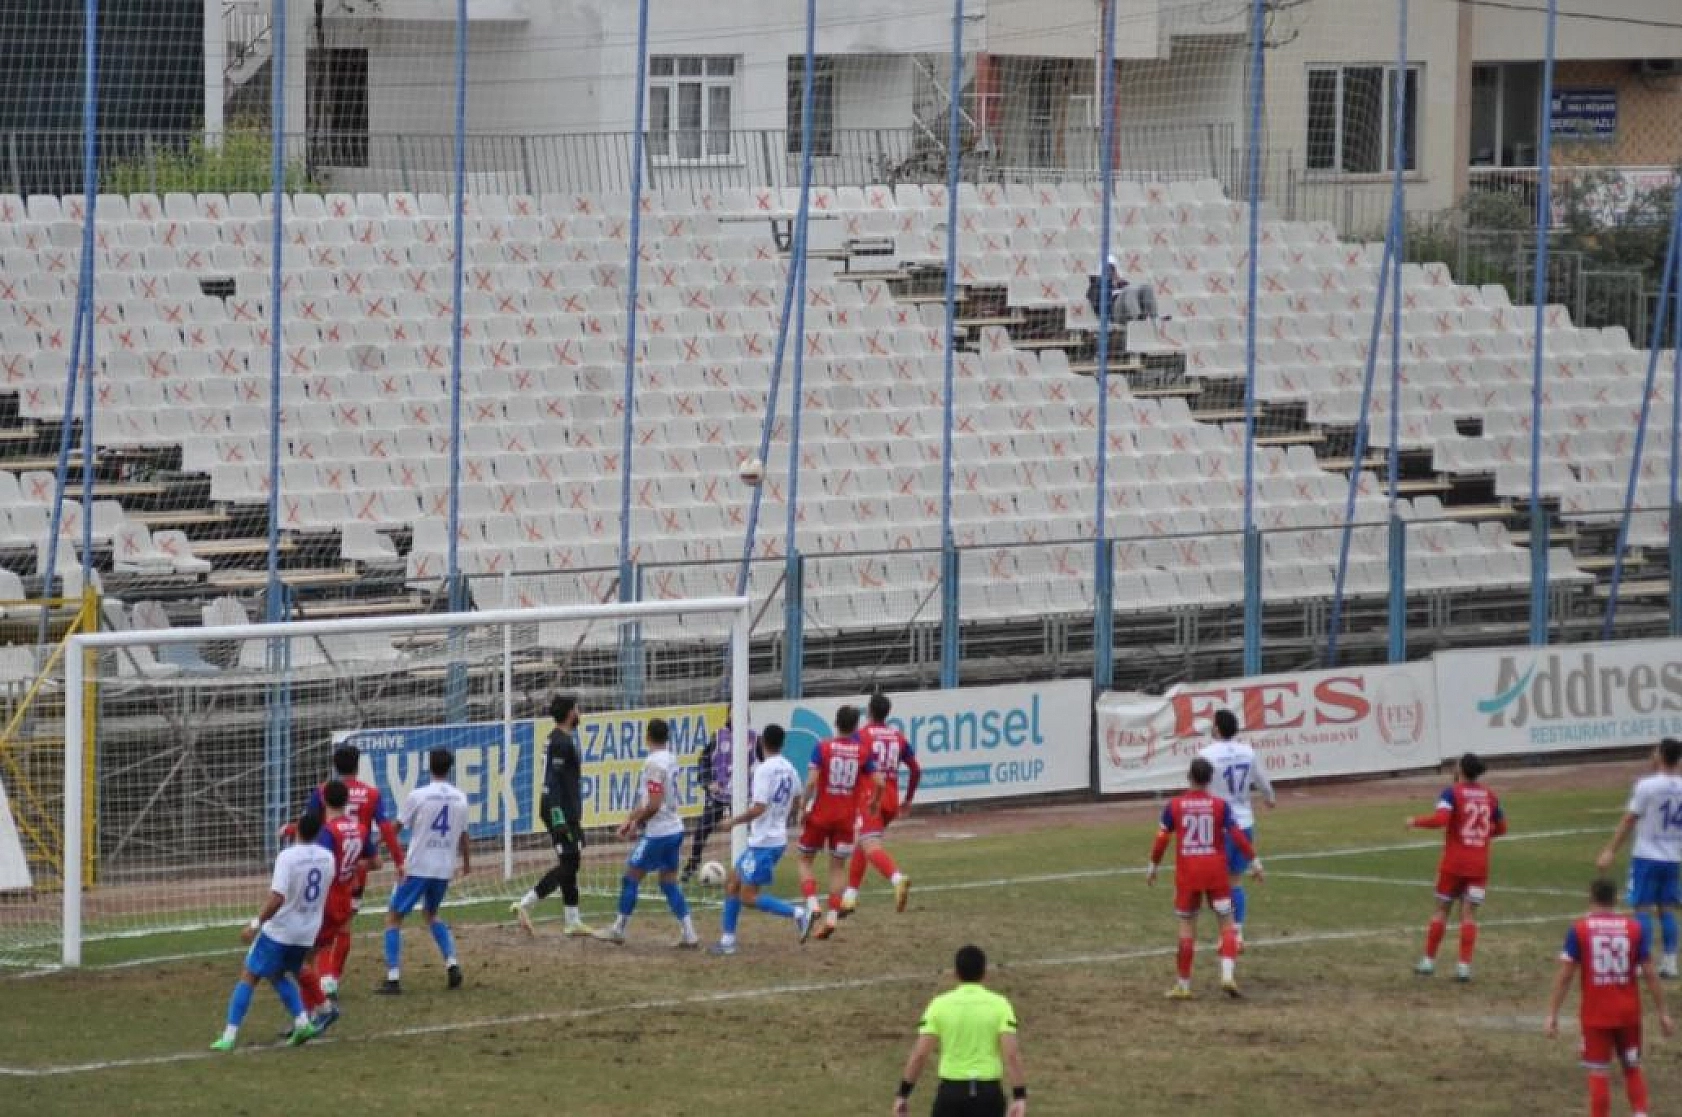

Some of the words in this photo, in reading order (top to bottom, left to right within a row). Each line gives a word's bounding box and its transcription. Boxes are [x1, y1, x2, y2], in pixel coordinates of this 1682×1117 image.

[886, 693, 1044, 753] ransel
[1163, 675, 1372, 740] FES
[1530, 722, 1616, 744] RESTAURANT
[1620, 719, 1658, 738] CAFE
[995, 759, 1044, 783] GRUP
[1223, 762, 1251, 796] 17
[429, 804, 450, 837] 4
[1181, 814, 1215, 847] 20
[1462, 803, 1491, 837] 23
[304, 868, 322, 902] 8
[1591, 935, 1631, 974] 53
